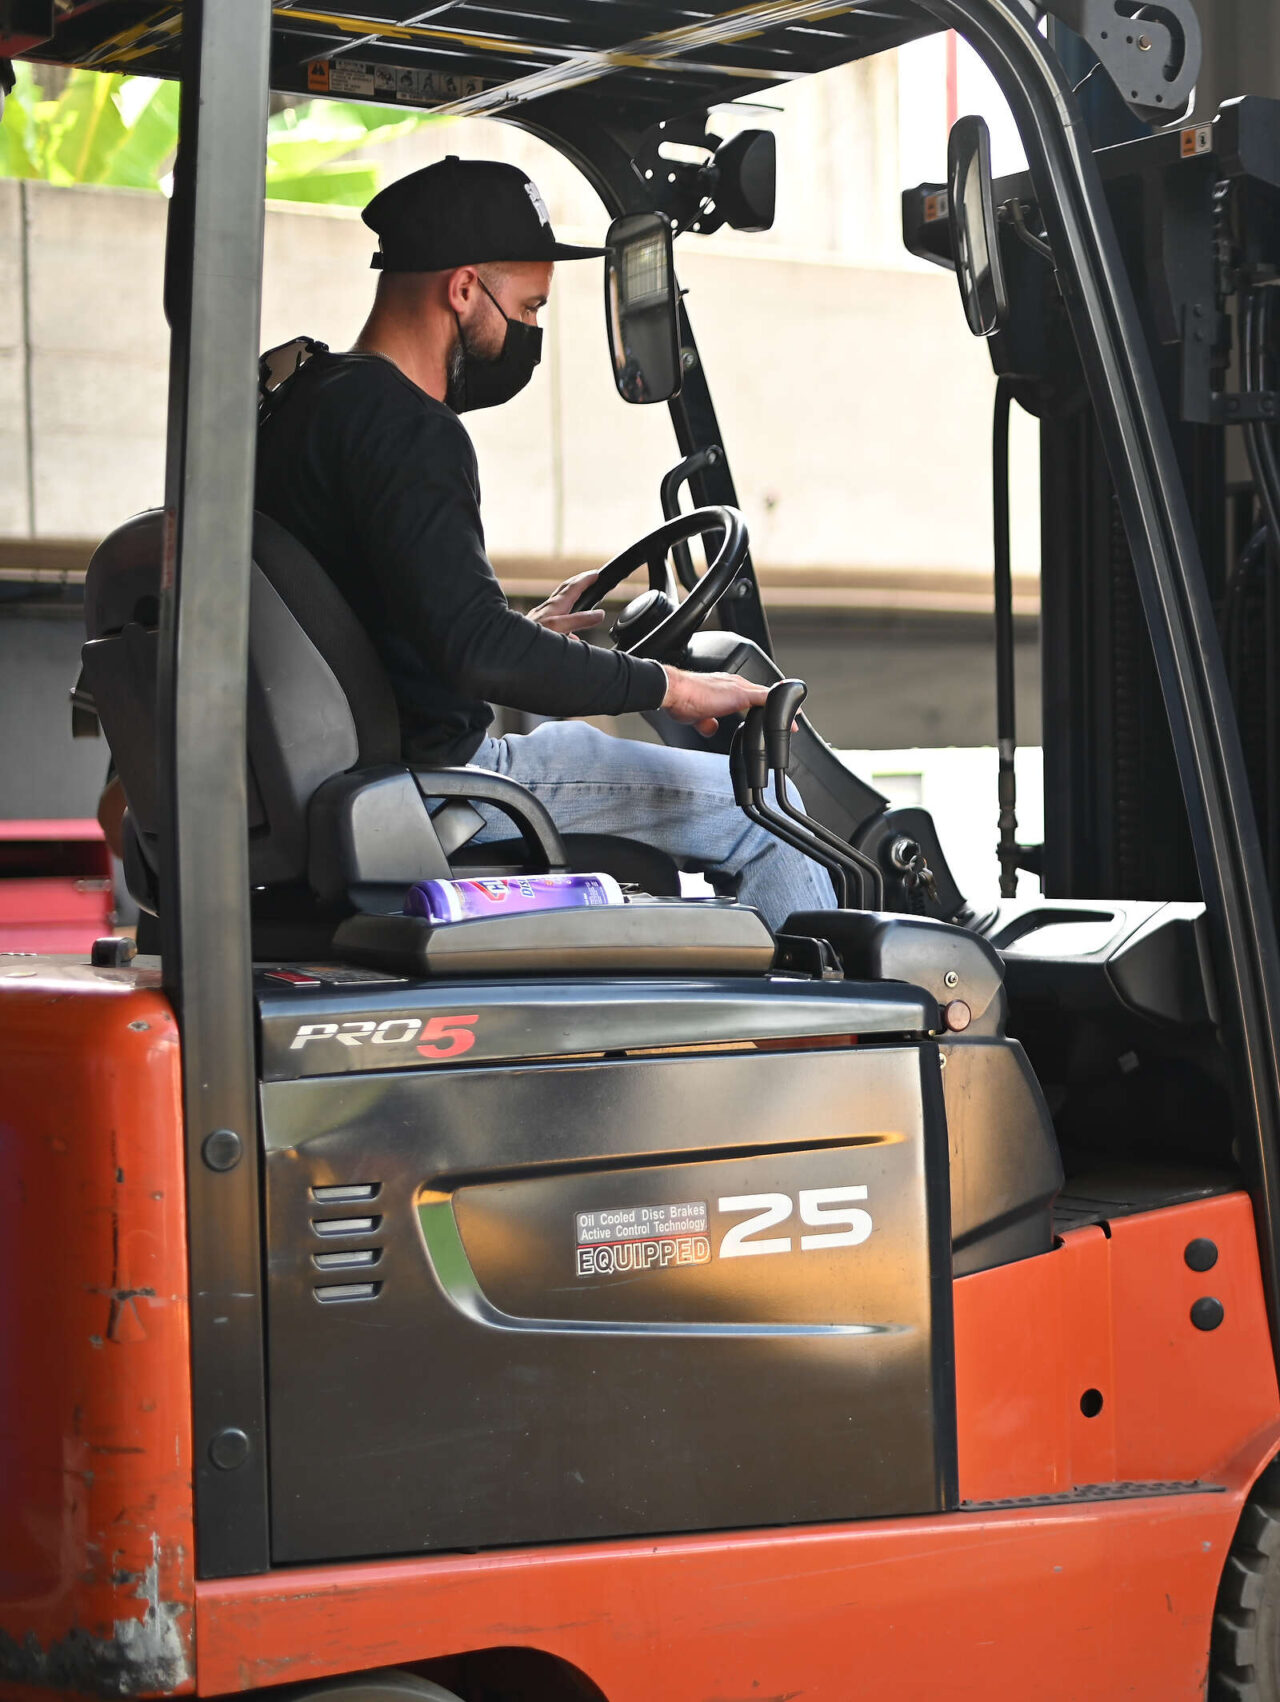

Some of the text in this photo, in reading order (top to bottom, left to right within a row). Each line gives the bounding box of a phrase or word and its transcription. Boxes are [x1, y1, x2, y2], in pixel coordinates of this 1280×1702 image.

[580, 1204, 705, 1227] Oil Cooled Disc Brakes
[580, 1218, 706, 1241] Active Control Technology
[718, 1185, 873, 1258] 25
[577, 1236, 710, 1275] EQUIPPED
